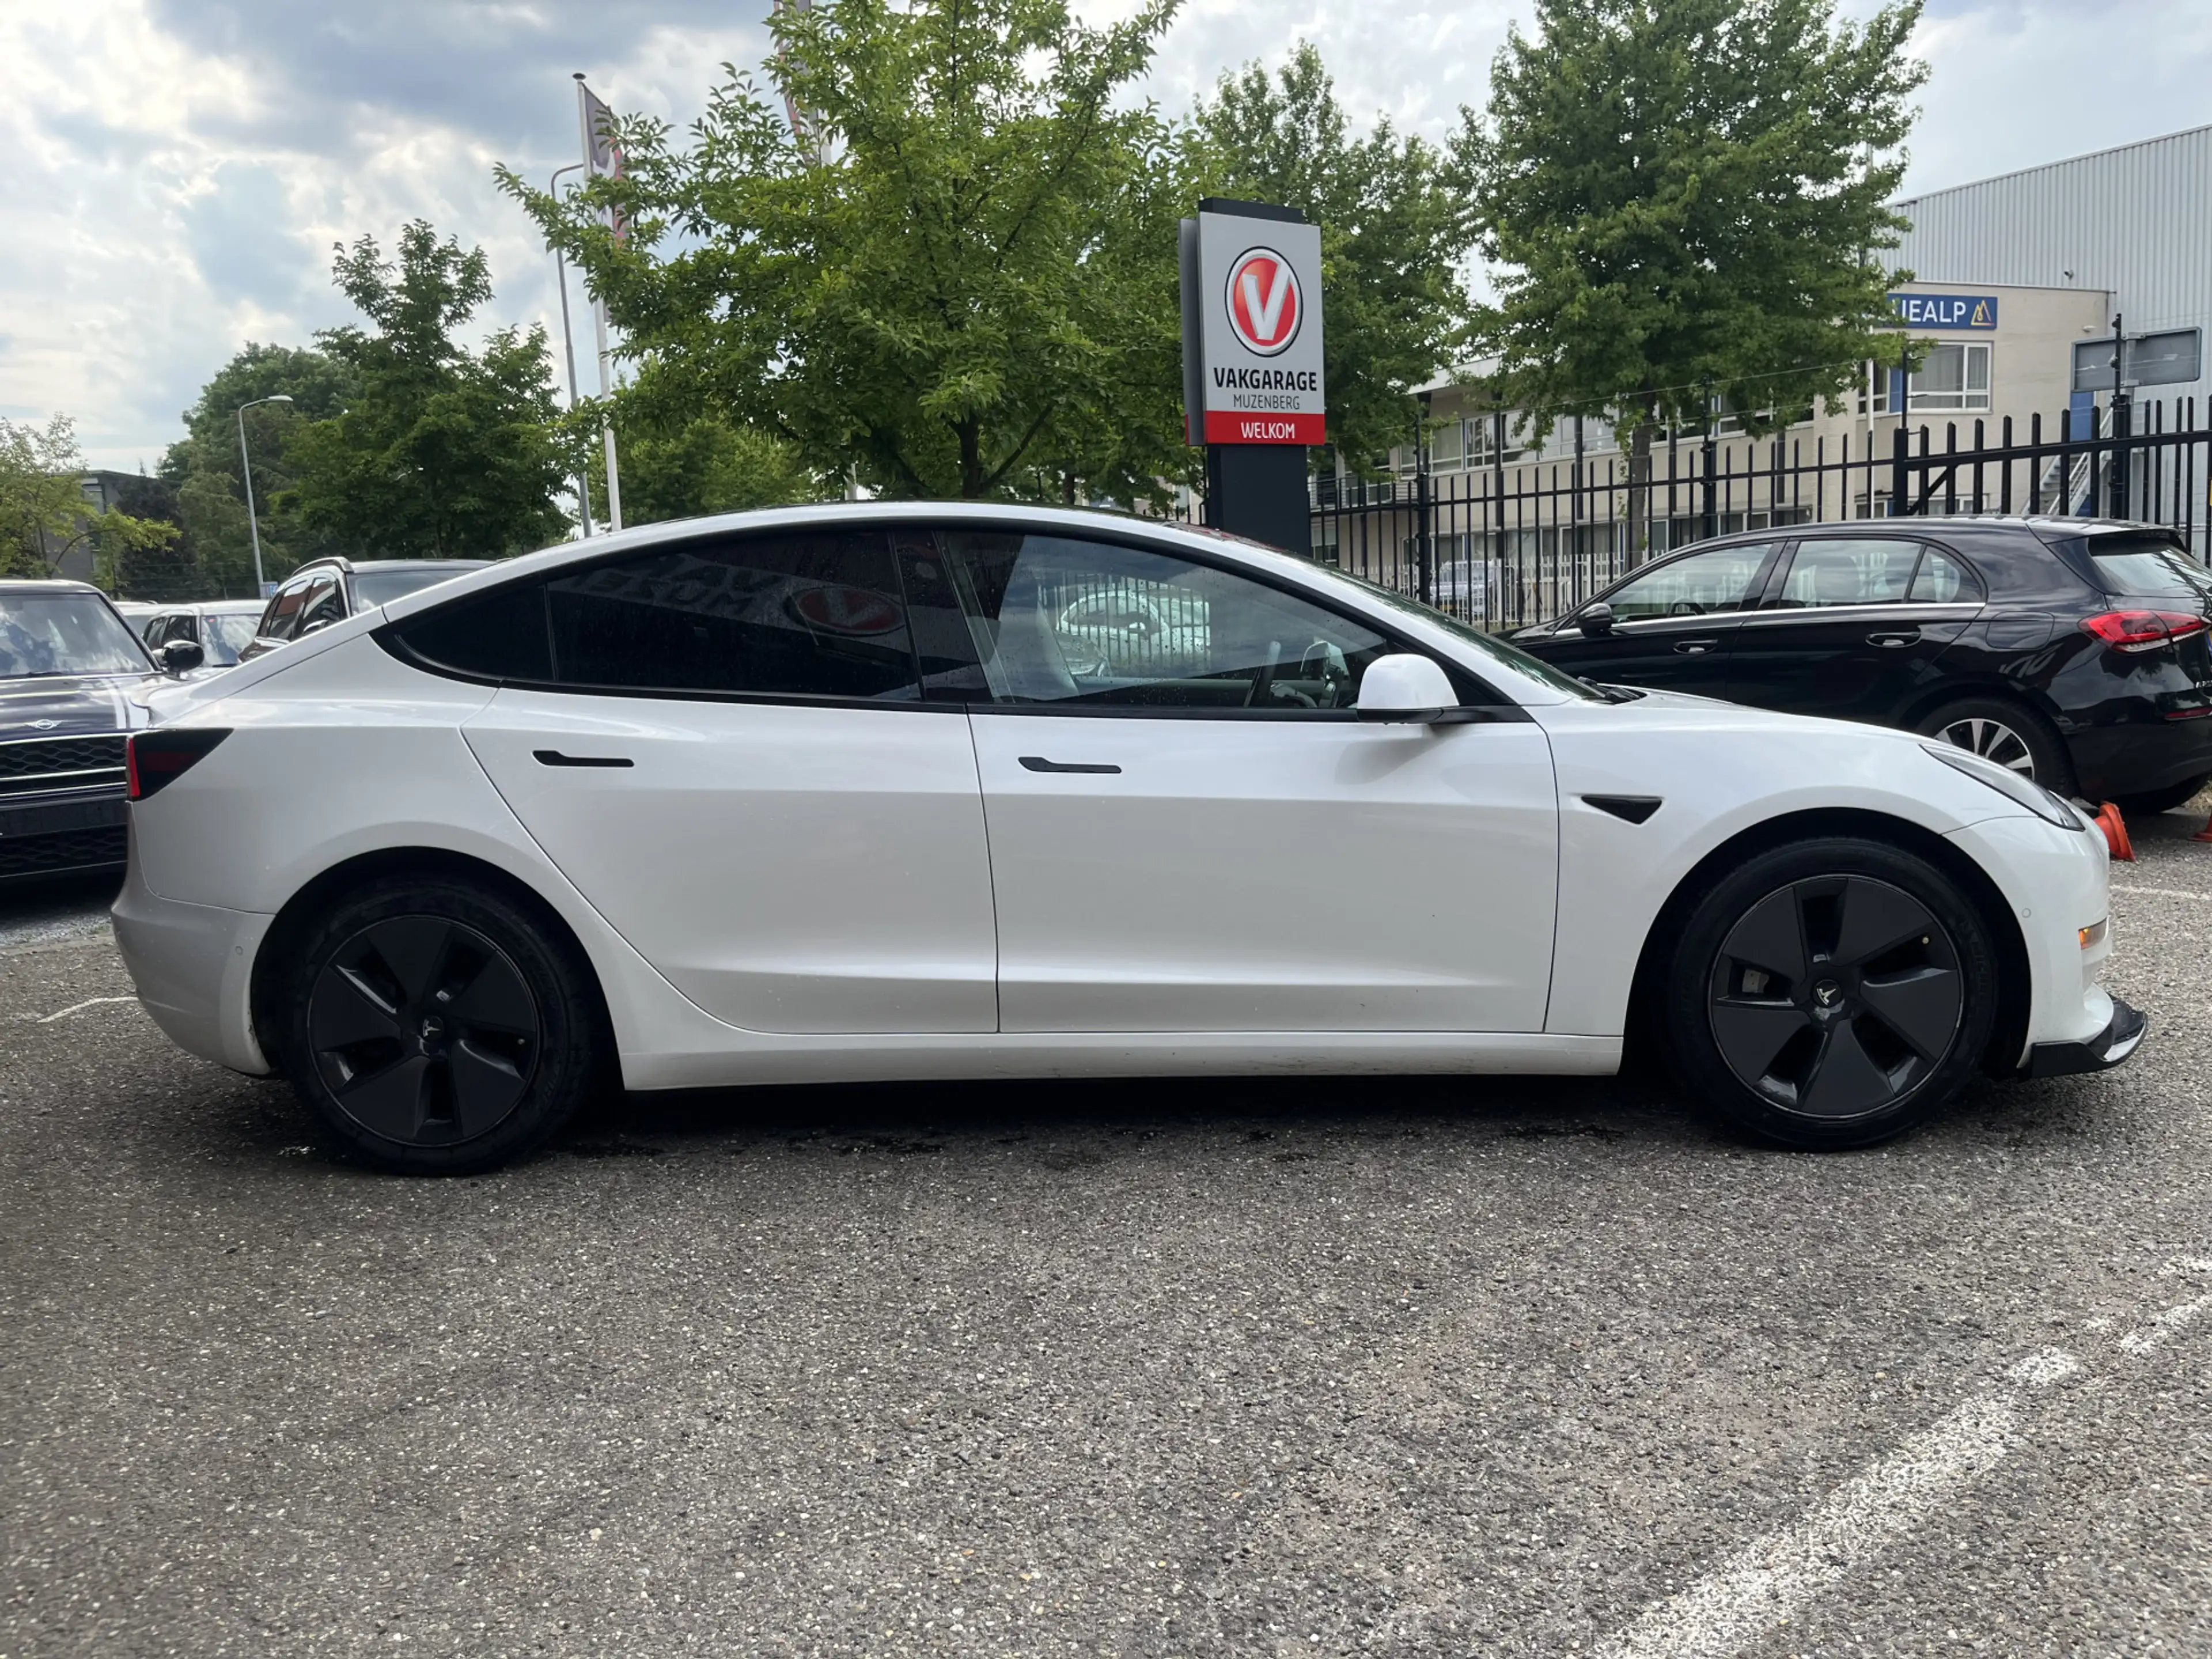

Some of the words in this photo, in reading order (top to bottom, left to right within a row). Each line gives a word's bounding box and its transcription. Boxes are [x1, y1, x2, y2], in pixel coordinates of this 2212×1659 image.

[1242, 259, 1291, 340] V
[1213, 367, 1317, 391] VAKGARAGE
[1233, 393, 1300, 410] MUZENBERG
[1240, 422, 1296, 439] WELKOM
